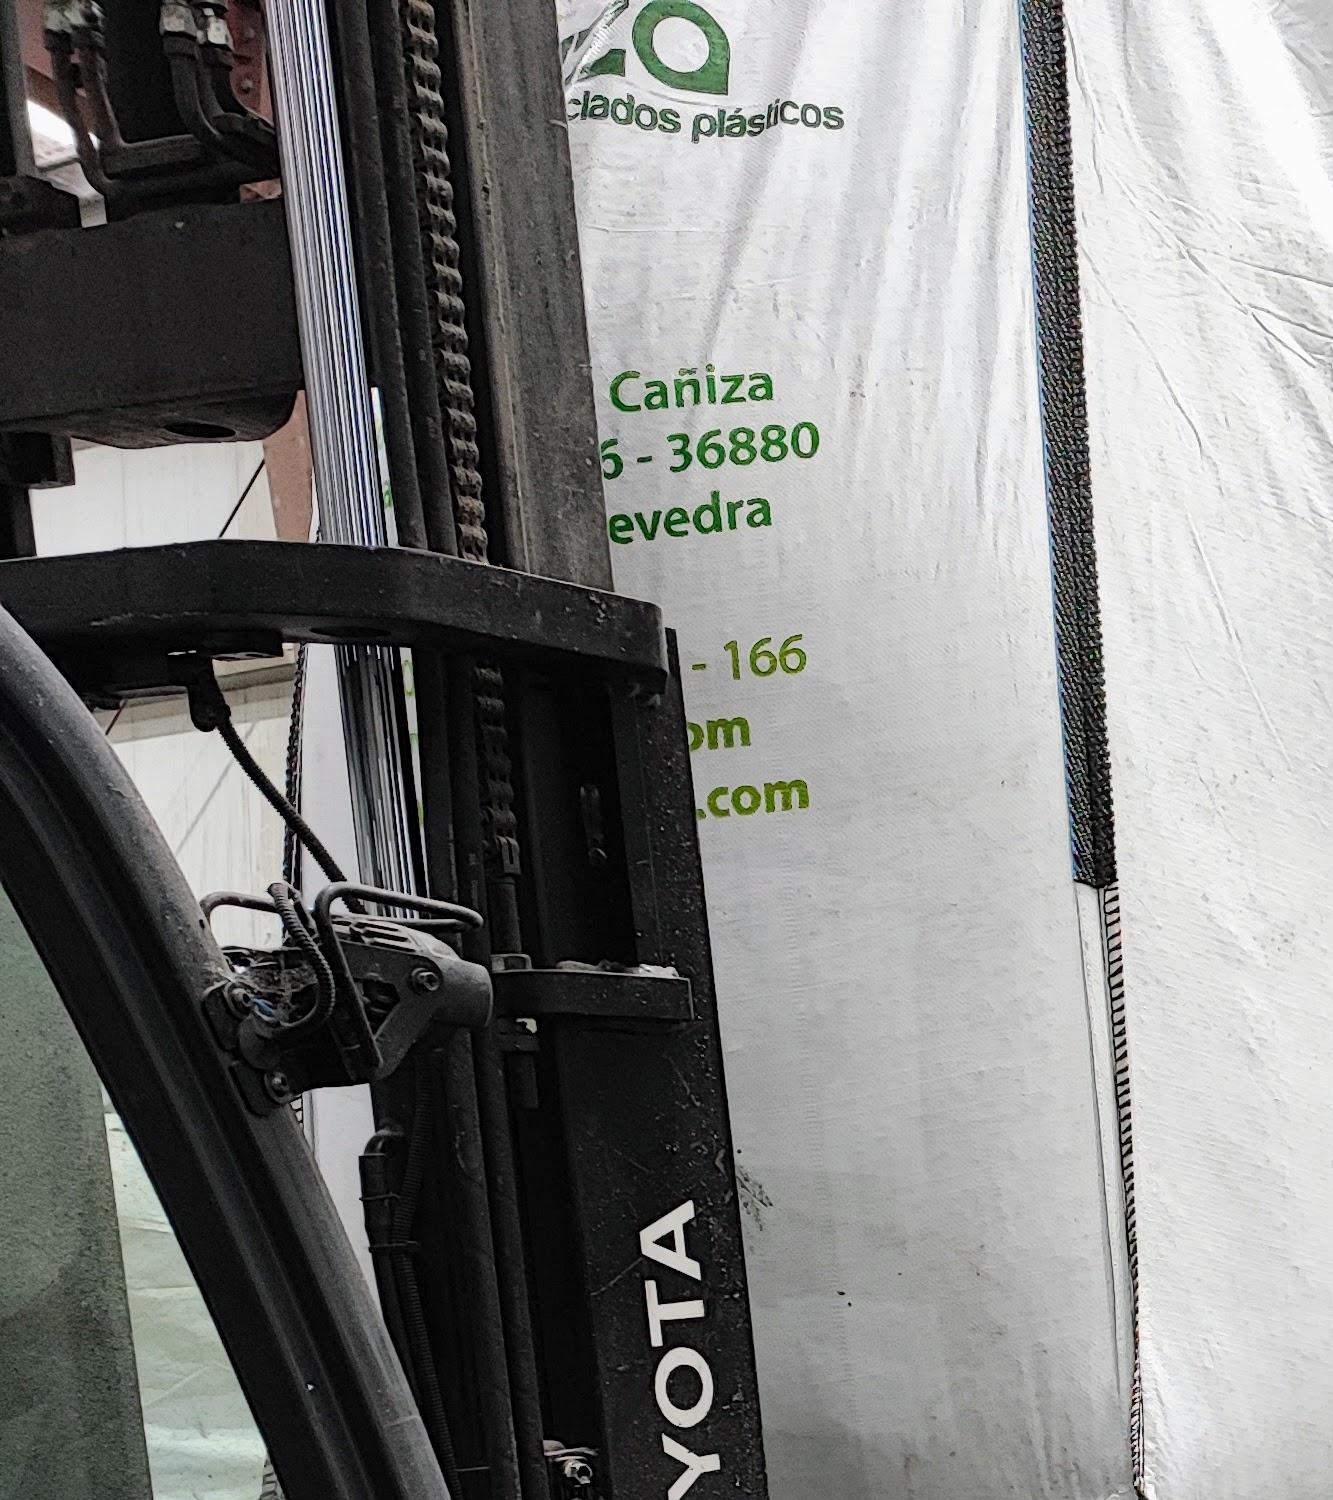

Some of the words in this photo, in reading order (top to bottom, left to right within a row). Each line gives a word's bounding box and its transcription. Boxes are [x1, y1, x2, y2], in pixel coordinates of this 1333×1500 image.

[609, 364, 774, 412] Cañiza
[667, 421, 820, 473] 36880
[724, 634, 808, 680] 166
